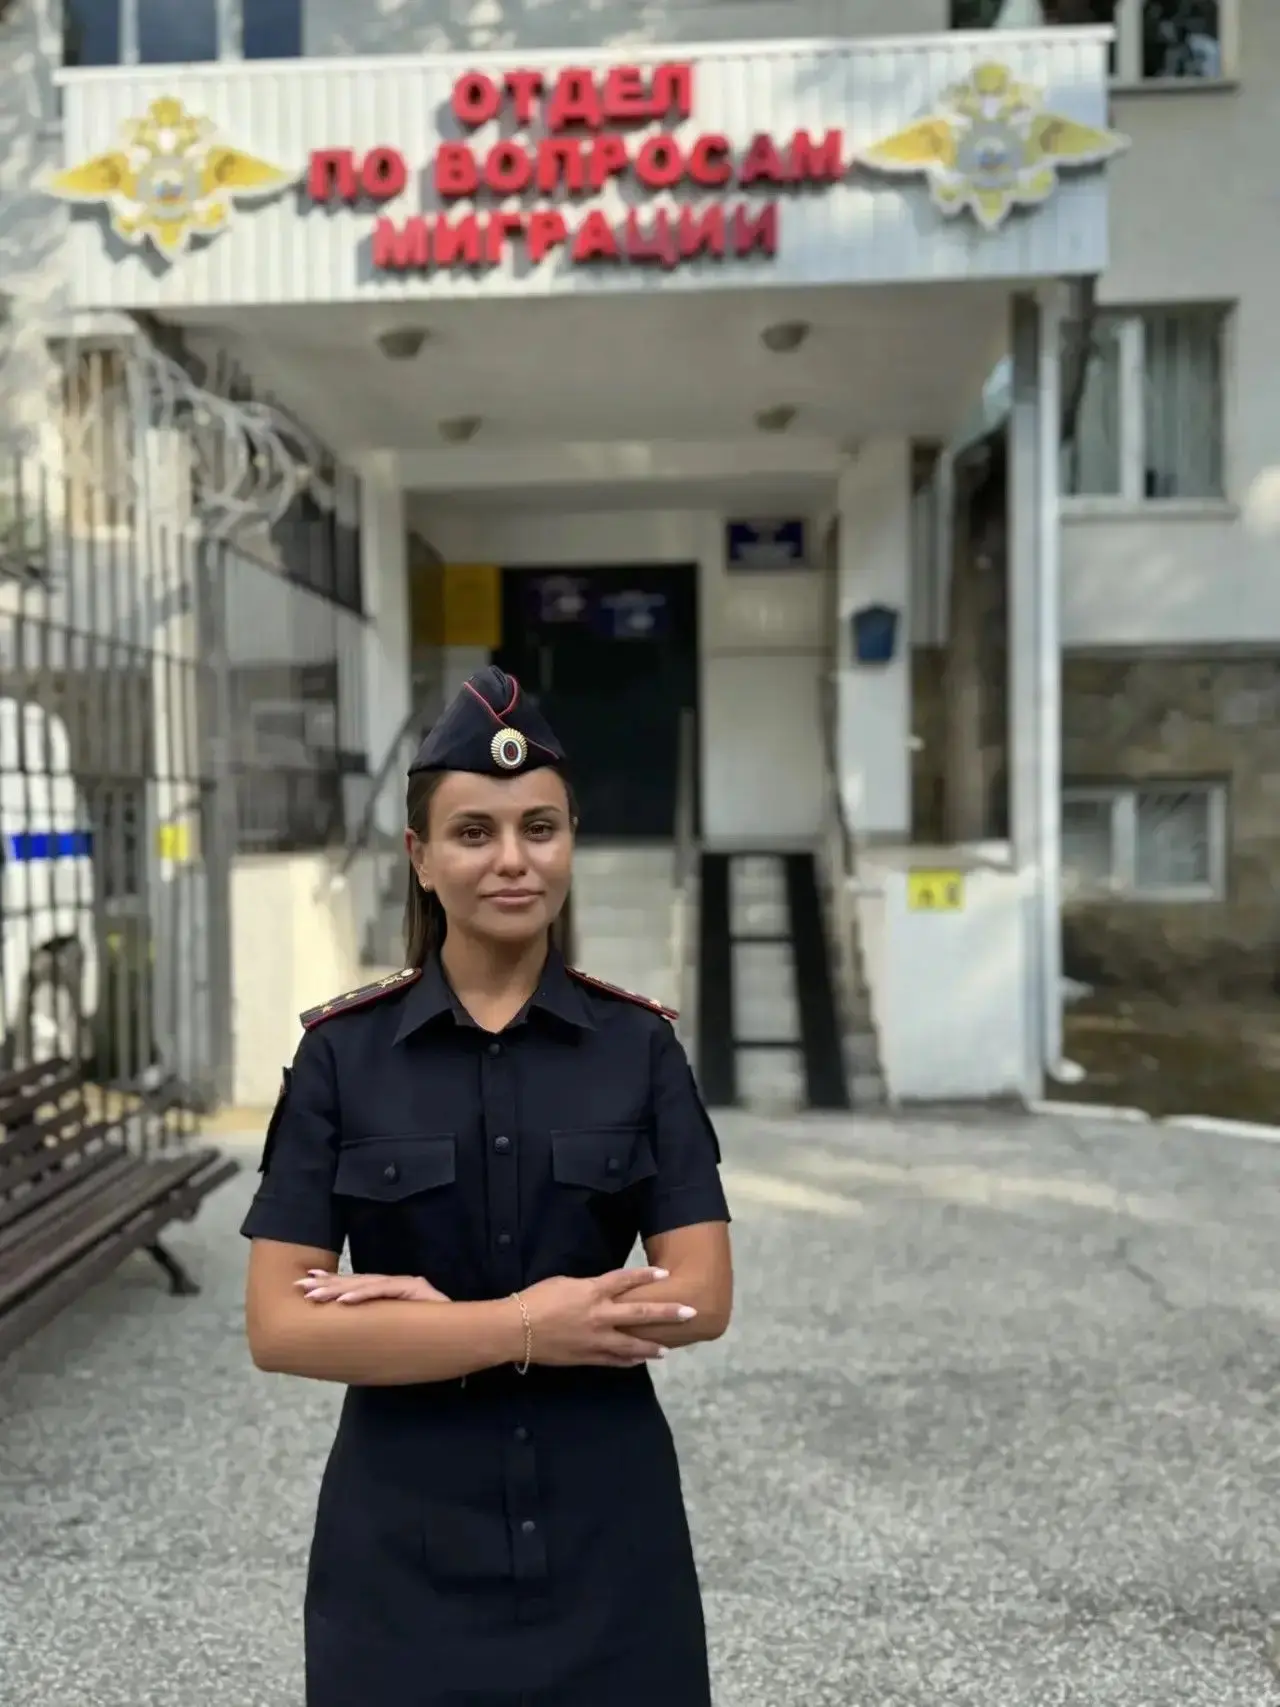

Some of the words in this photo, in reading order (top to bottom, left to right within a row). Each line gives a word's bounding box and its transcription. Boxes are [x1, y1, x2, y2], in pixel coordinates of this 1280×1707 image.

[451, 62, 694, 131] ОТДЕЛ
[308, 146, 407, 202] ПО
[433, 129, 845, 197] ВОПРОСАМ
[371, 202, 780, 269] МИГРАЦИИ
